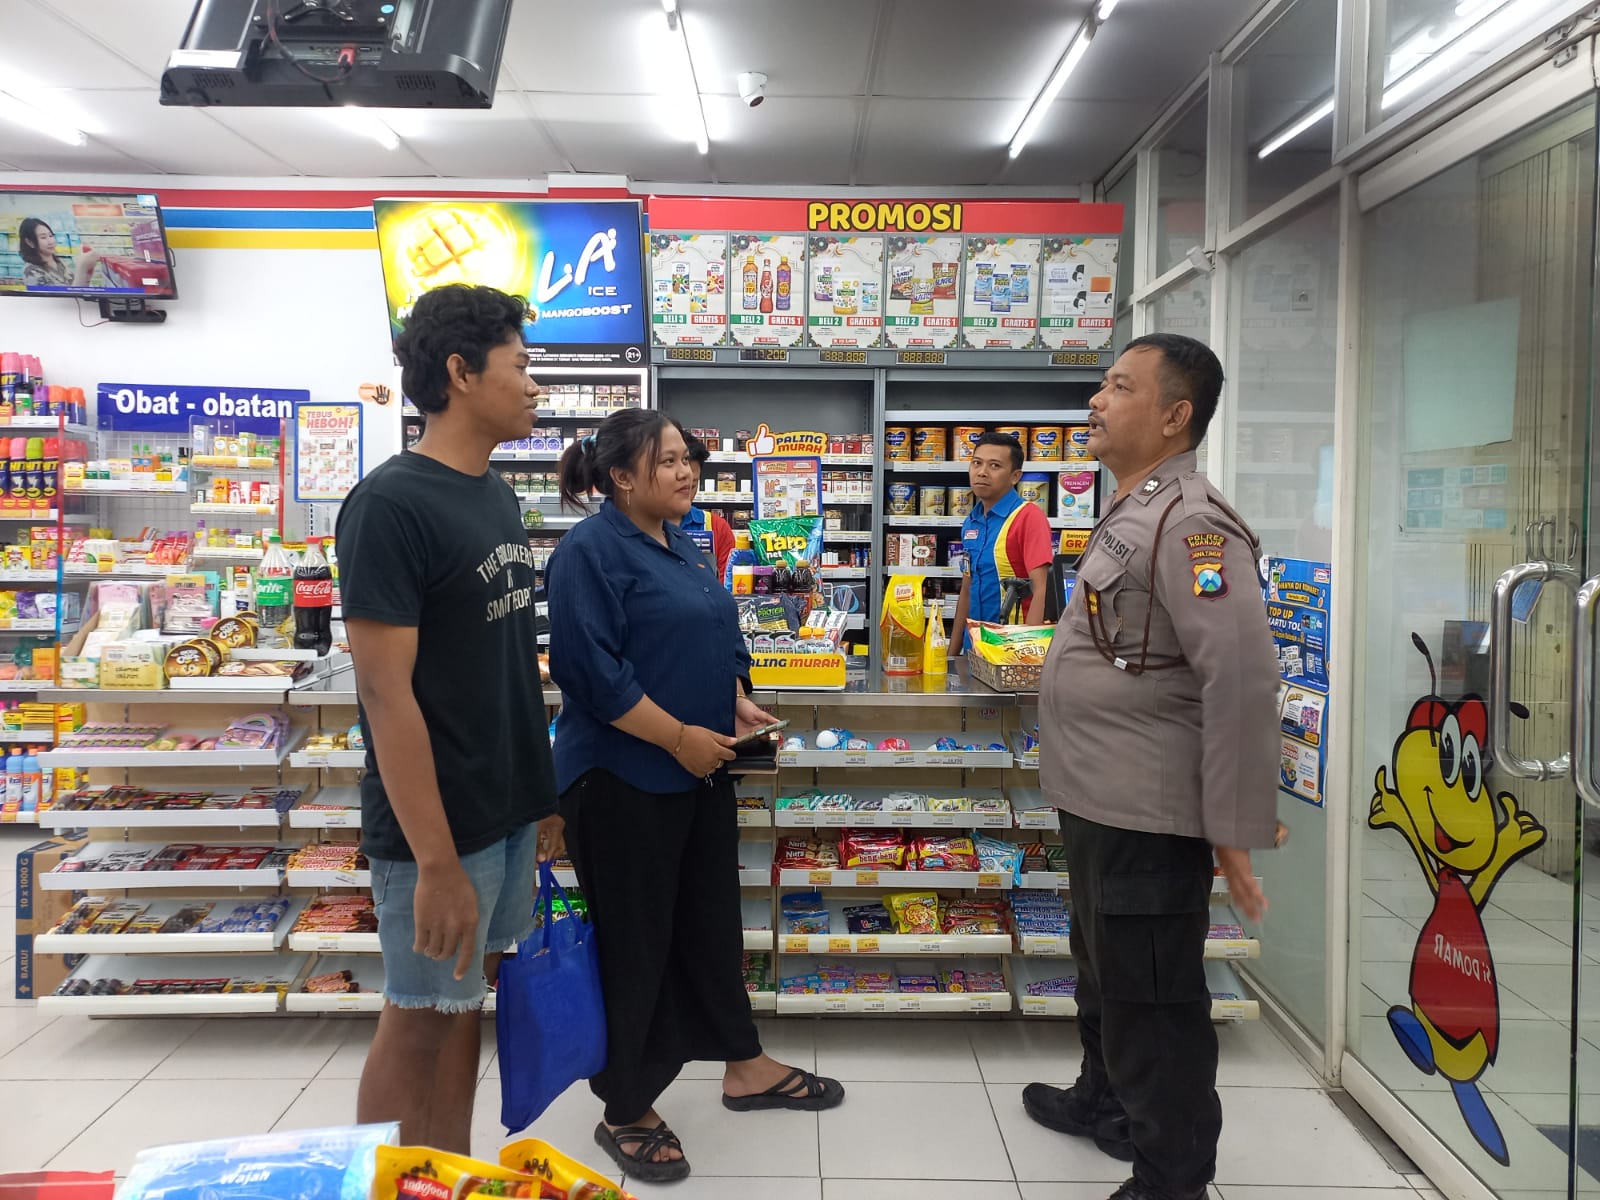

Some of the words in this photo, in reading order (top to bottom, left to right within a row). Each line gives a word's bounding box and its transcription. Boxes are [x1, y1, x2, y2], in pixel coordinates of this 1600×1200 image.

[807, 202, 963, 232] PROMOSI
[588, 286, 617, 296] ICE
[542, 304, 632, 319] MANGOBOOST
[694, 316, 719, 324] GRATIS
[771, 316, 796, 325] GRATIS
[849, 317, 874, 326] GRATIS
[926, 317, 951, 326] GRATIS
[1004, 319, 1029, 327] GRATIS
[1081, 319, 1106, 327] GRATIS
[115, 389, 180, 415] Obat
[202, 392, 293, 418] obatan
[306, 417, 354, 429] HEBOH!
[776, 434, 823, 445] PALING
[778, 443, 823, 454] MURAH
[760, 532, 807, 552] Taro
[1101, 529, 1130, 559] POLISI
[476, 553, 500, 584] THE
[1269, 606, 1282, 617] TOP
[1283, 609, 1294, 620] UP
[1288, 621, 1301, 632] TOL
[750, 658, 787, 668] ALING
[789, 658, 841, 668] MURAH
[20, 866, 29, 886] 1000
[20, 897, 29, 909] 10
[952, 922, 981, 936] Maxx
[20, 949, 29, 980] BARU!
[402, 1178, 449, 1198] Indofood
